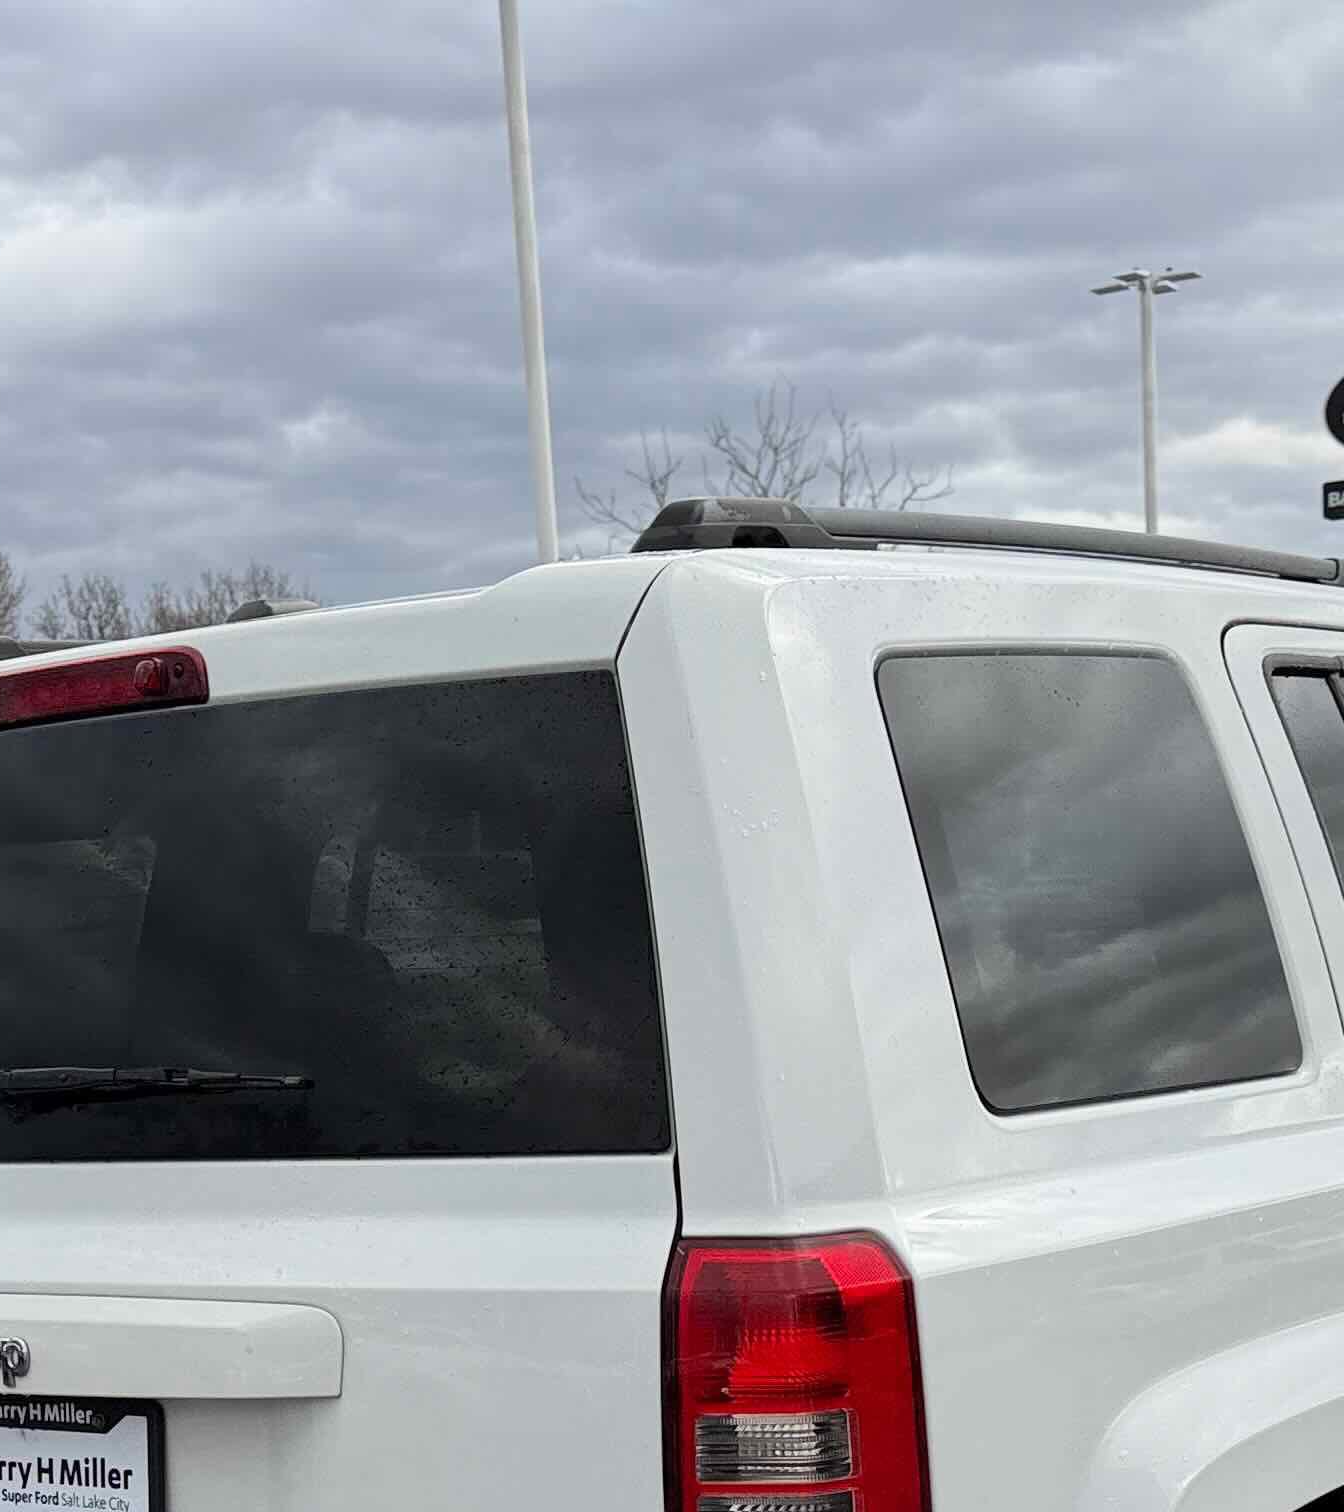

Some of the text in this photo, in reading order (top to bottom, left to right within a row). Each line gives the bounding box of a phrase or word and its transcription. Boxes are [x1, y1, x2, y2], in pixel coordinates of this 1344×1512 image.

[30, 1403, 42, 1420] H
[44, 1403, 93, 1424] Miller
[37, 1457, 54, 1484] H
[60, 1457, 133, 1490] Miller
[1, 1488, 130, 1512] Super Ford Salt Lake City
